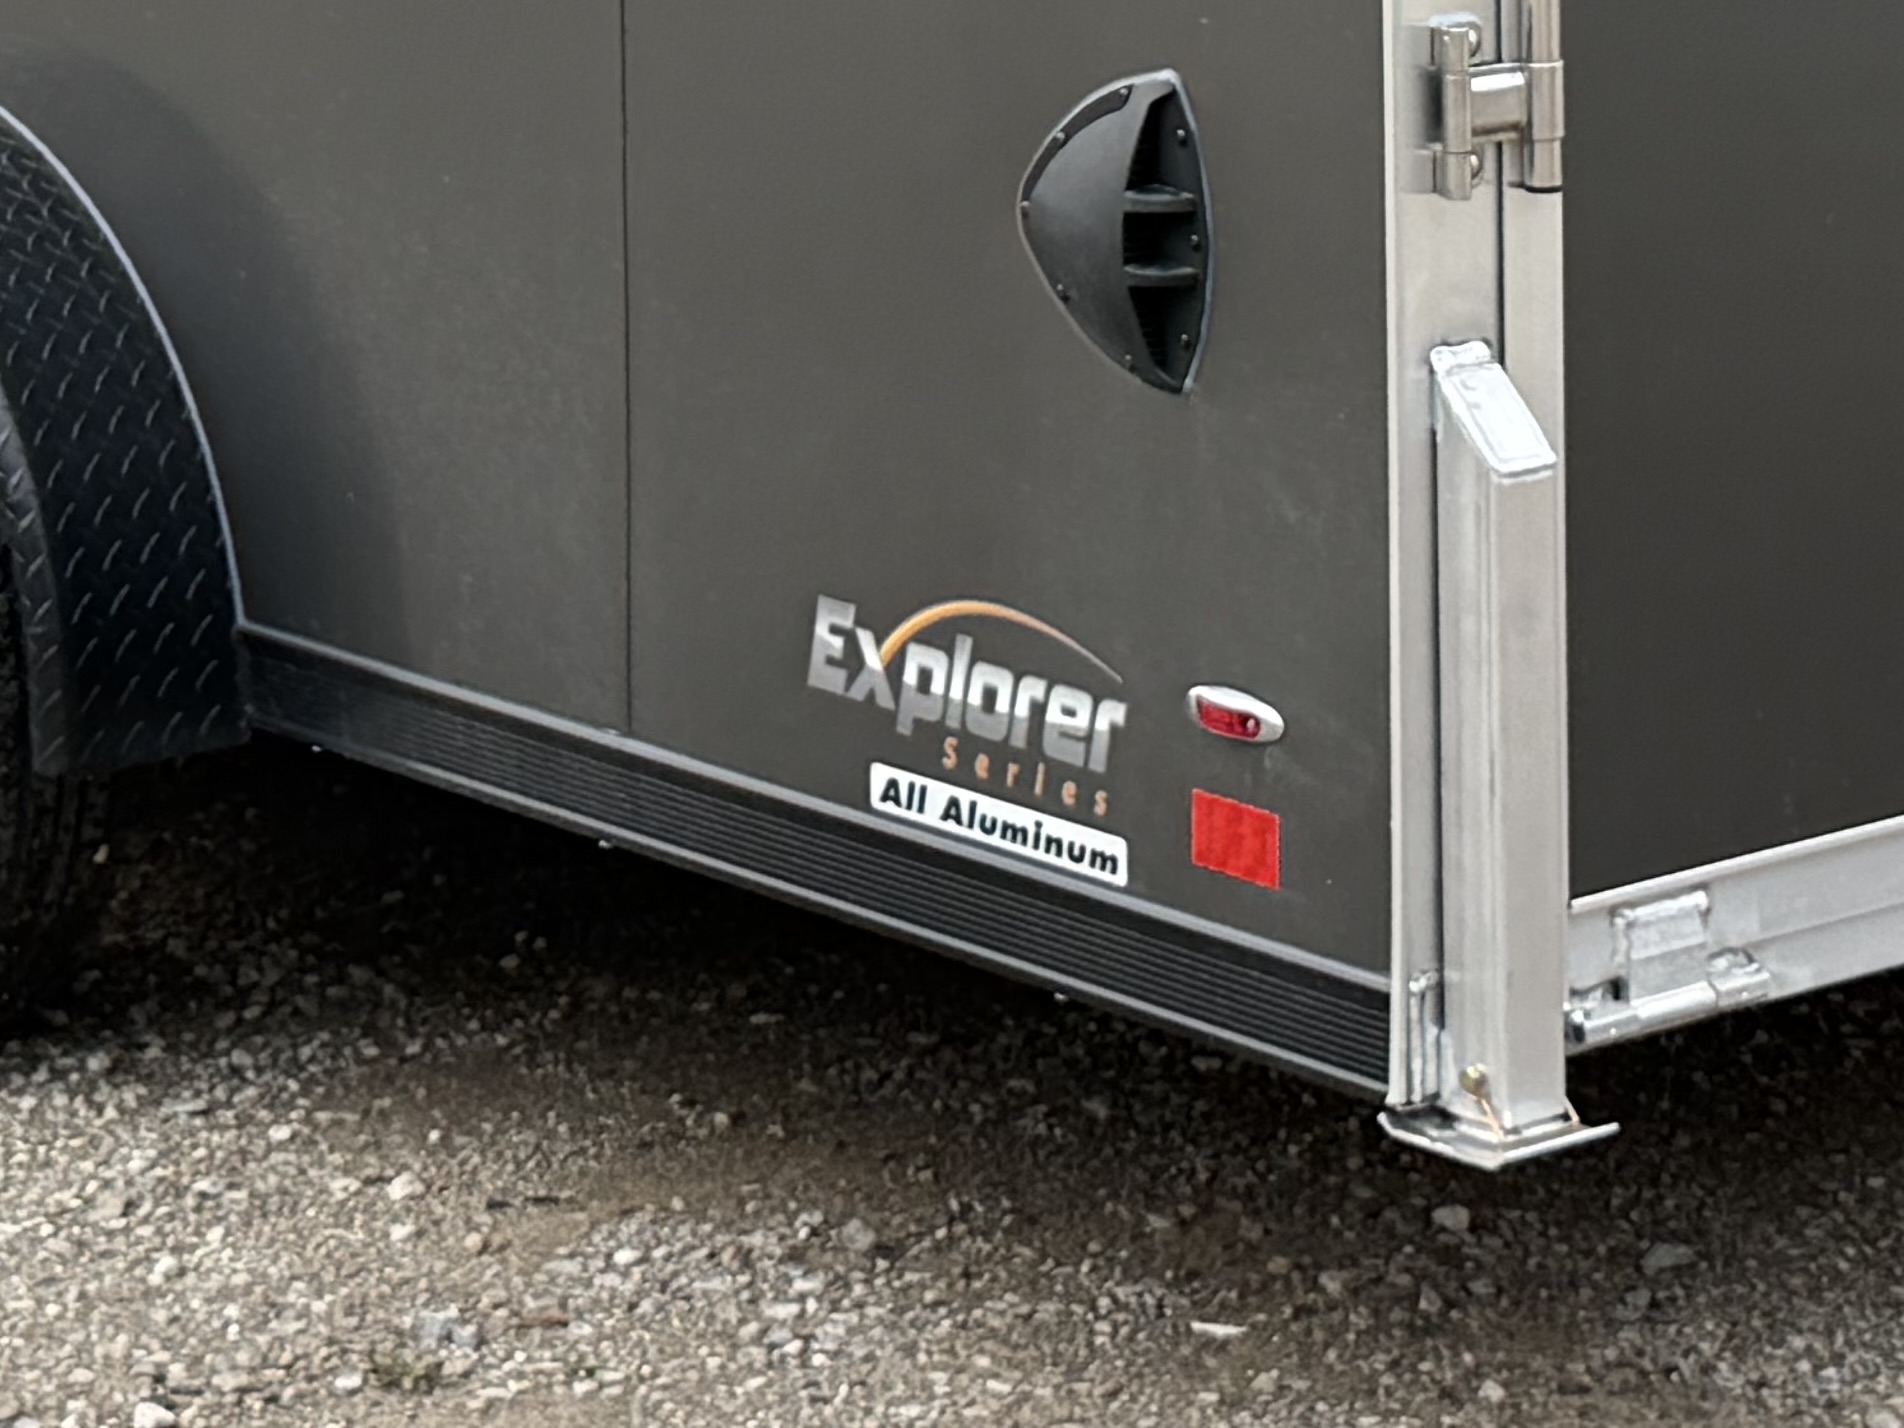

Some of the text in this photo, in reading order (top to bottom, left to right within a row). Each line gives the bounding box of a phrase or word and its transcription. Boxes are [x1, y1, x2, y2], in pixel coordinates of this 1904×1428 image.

[807, 595, 1128, 773] Explorer
[941, 736, 1109, 817] Series
[879, 777, 1119, 875] All Aluminum
